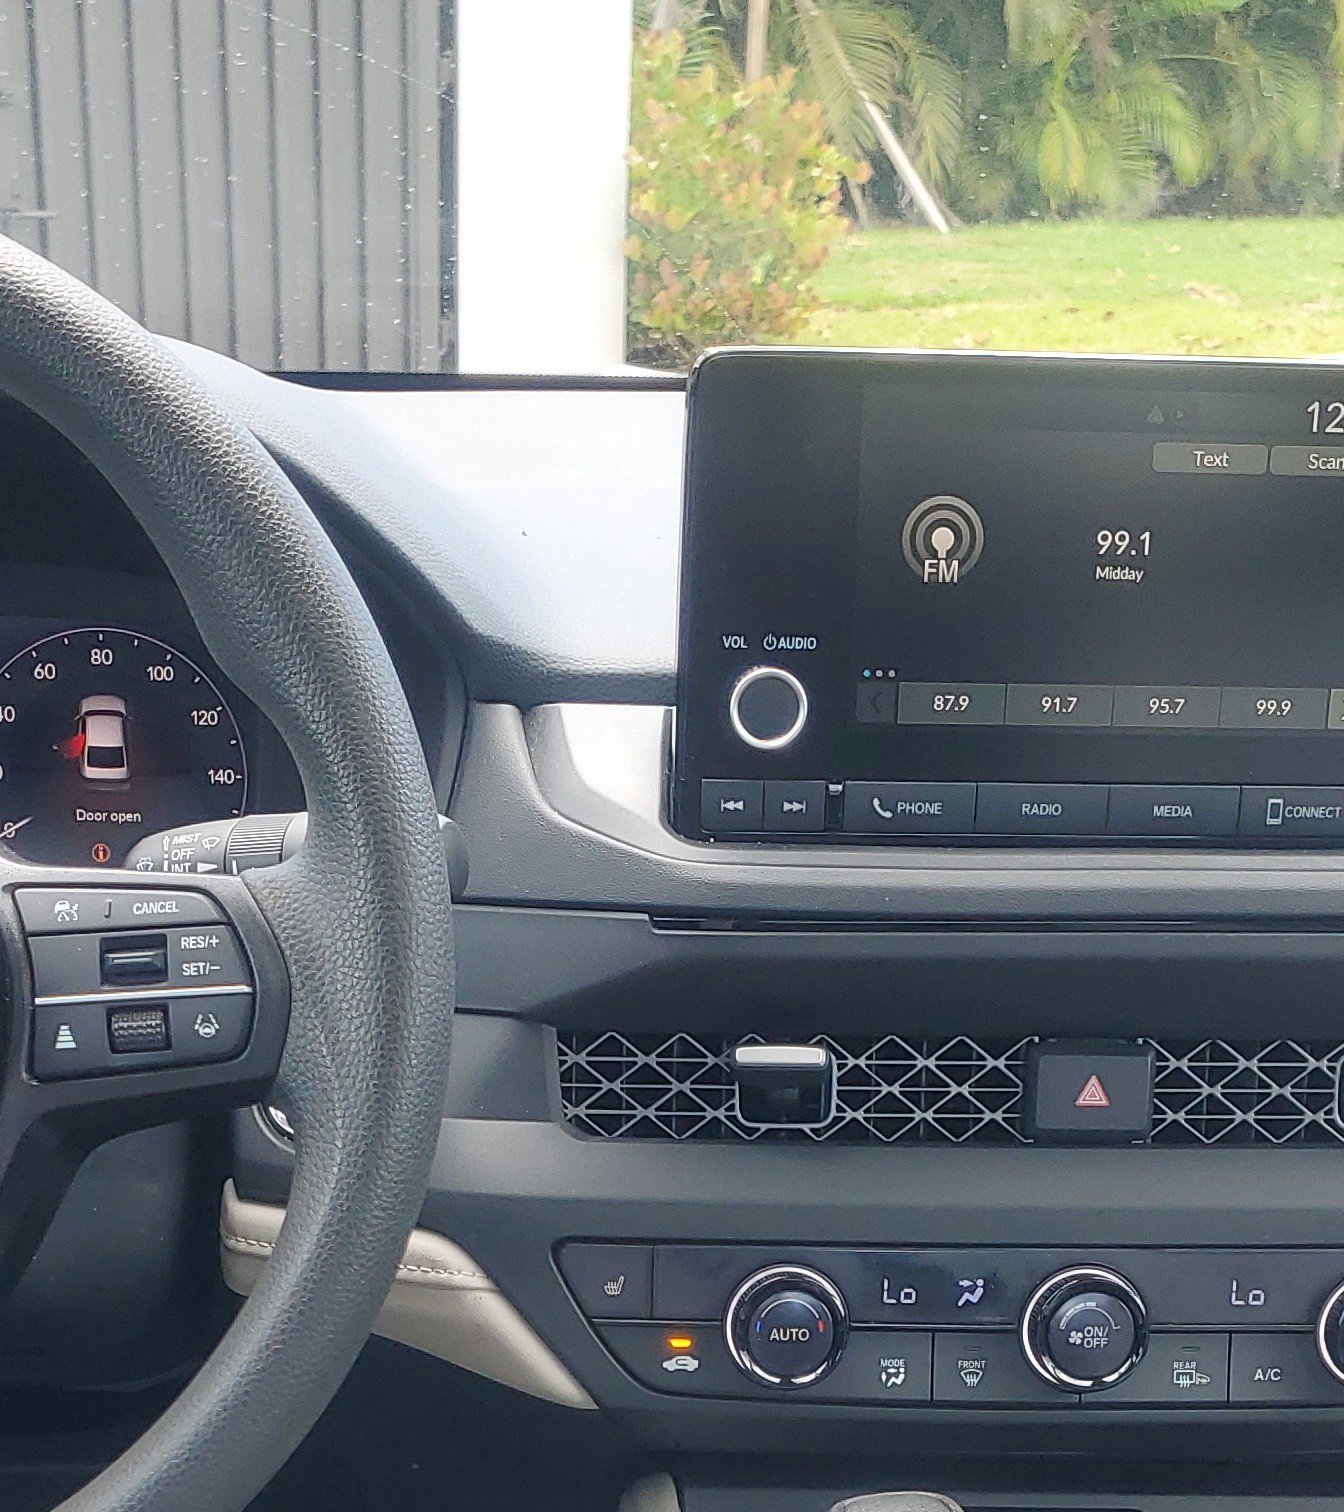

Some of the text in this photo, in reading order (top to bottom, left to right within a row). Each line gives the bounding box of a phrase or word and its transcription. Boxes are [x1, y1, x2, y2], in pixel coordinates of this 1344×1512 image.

[1192, 450, 1230, 468] Text
[1096, 530, 1151, 556] 99.1
[921, 560, 959, 584] FM
[1095, 565, 1144, 583] Midday
[722, 635, 817, 650] VOL AUDIO
[90, 648, 113, 666] 80
[33, 663, 56, 680] 60
[146, 665, 174, 681] 100
[933, 695, 970, 711] 87.9
[1041, 696, 1078, 713] 91.7
[1149, 697, 1185, 714] 95.7
[1256, 699, 1292, 716] 99.9
[190, 709, 218, 726] 120
[207, 768, 235, 785] 140
[897, 801, 943, 815] PHONE
[1021, 803, 1062, 816] RADIO
[1153, 805, 1193, 818] MEDIA
[1285, 804, 1342, 819] CONNECT
[75, 808, 142, 826] Door open
[171, 832, 202, 845] MIST
[171, 848, 195, 861] OFF
[171, 862, 191, 873] INT
[132, 900, 180, 915] CANCEL
[769, 1327, 810, 1341] AUTO
[1083, 1338, 1109, 1350] OFF
[880, 1358, 906, 1369] MODE
[957, 1359, 987, 1371] FRONT
[1172, 1360, 1198, 1371] REAR
[1253, 1368, 1281, 1381] A/C
